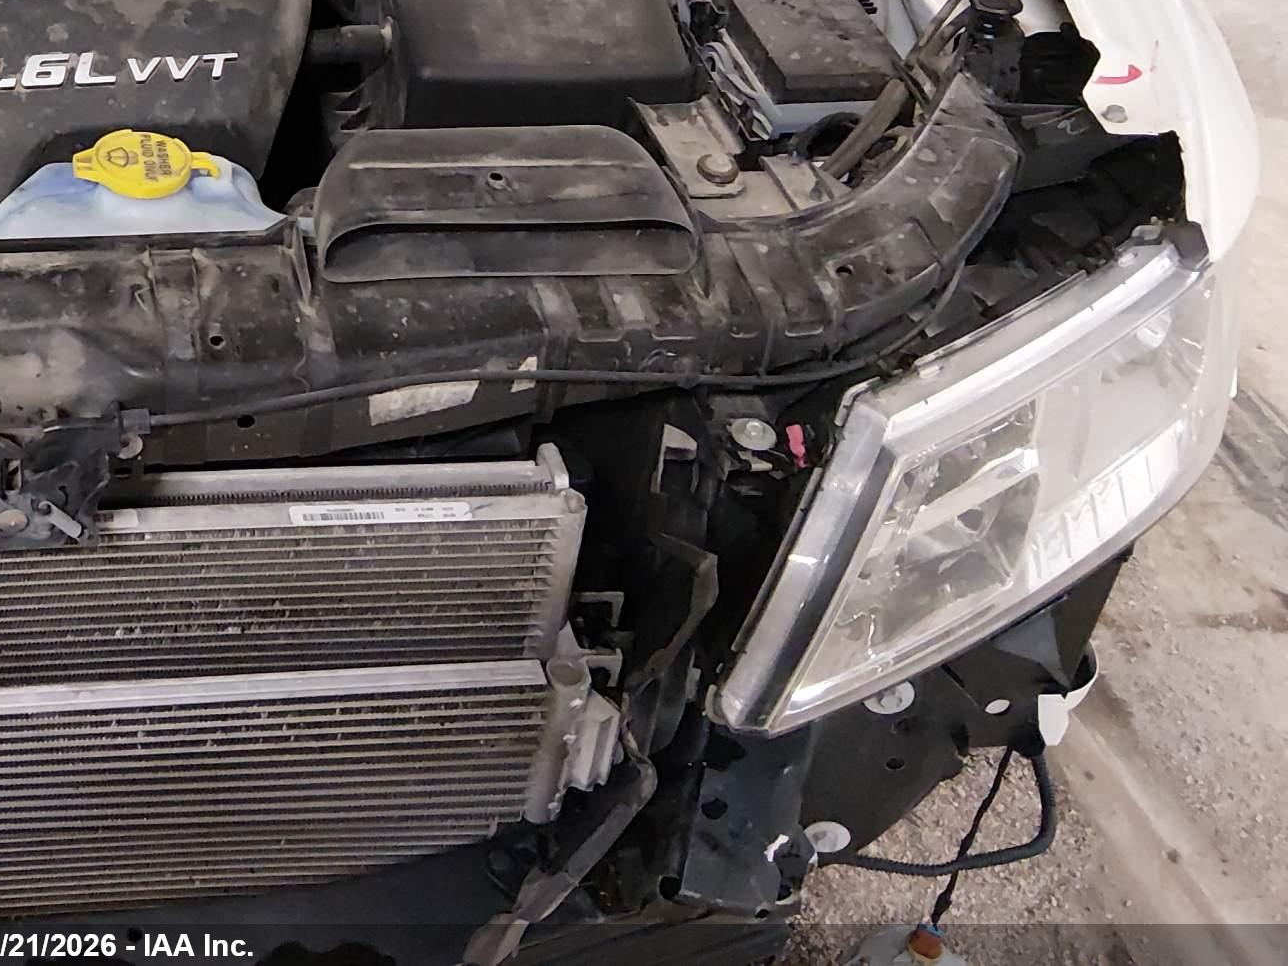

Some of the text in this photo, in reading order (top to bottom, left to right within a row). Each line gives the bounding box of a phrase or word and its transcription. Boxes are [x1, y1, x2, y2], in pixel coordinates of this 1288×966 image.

[128, 52, 239, 82] VVT
[140, 133, 160, 183] FLUID ONLY
[155, 139, 173, 178] WASHER
